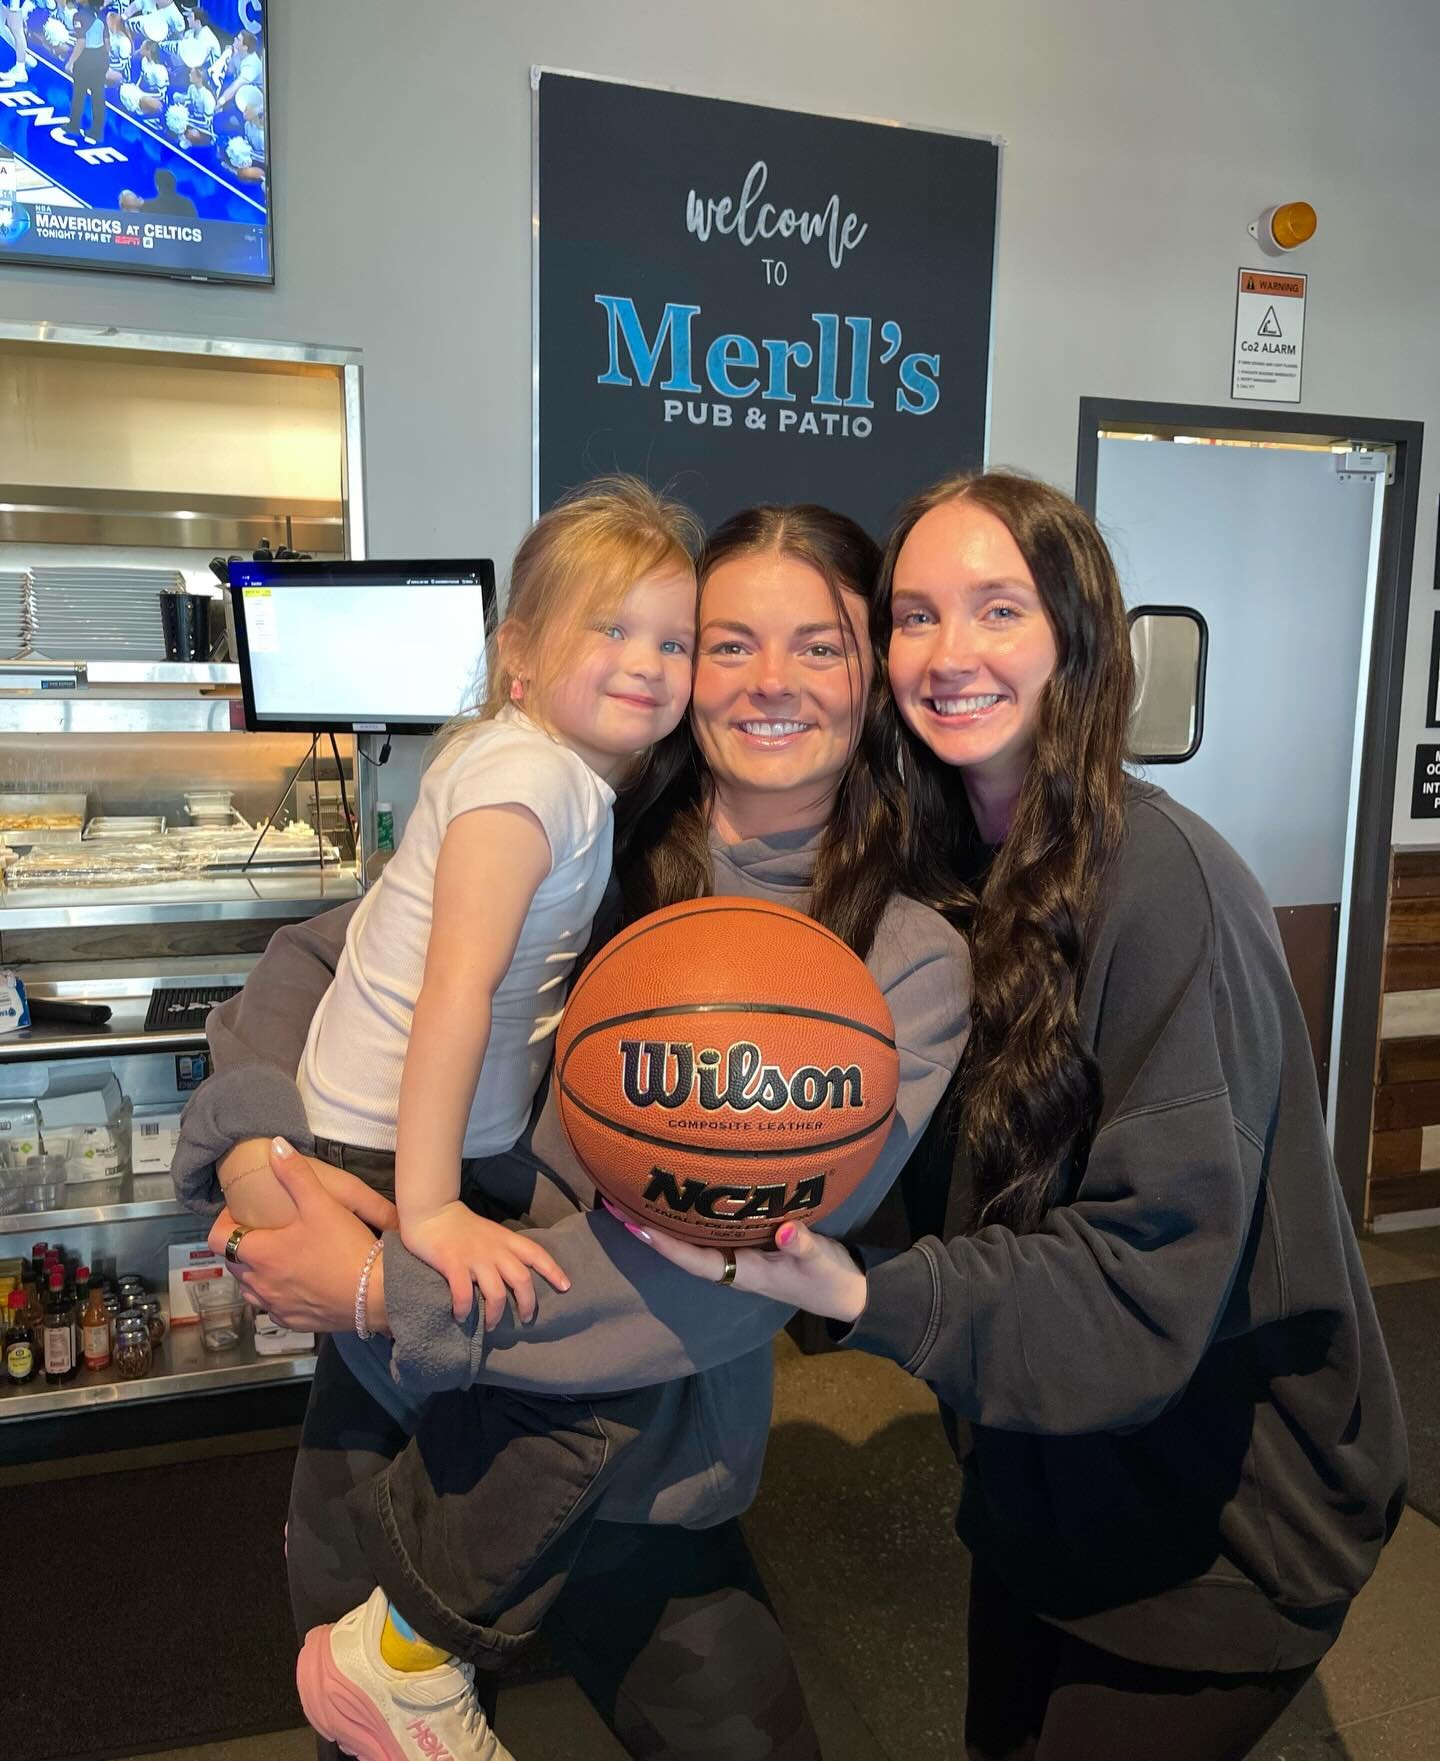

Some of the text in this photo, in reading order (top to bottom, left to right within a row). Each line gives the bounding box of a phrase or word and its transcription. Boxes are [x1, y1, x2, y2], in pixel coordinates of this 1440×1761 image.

[35, 204, 52, 212] NBA
[686, 160, 868, 268] welcome
[35, 213, 202, 242] MAVERICKS AT CELTICS
[36, 228, 77, 240] TONIGHT
[85, 233, 99, 242] PM
[101, 234, 112, 243] ET
[114, 235, 140, 246] ESPN
[762, 258, 788, 286] TO
[1259, 279, 1299, 293] WARNING
[594, 294, 941, 415] Merll's
[1241, 340, 1297, 355] Co2 ALARM
[663, 400, 873, 438] PUB & PATIO
[618, 1039, 864, 1113] Wilson
[668, 1119, 823, 1131] COMPOSITE LEATHER
[643, 1166, 825, 1221] NCAA
